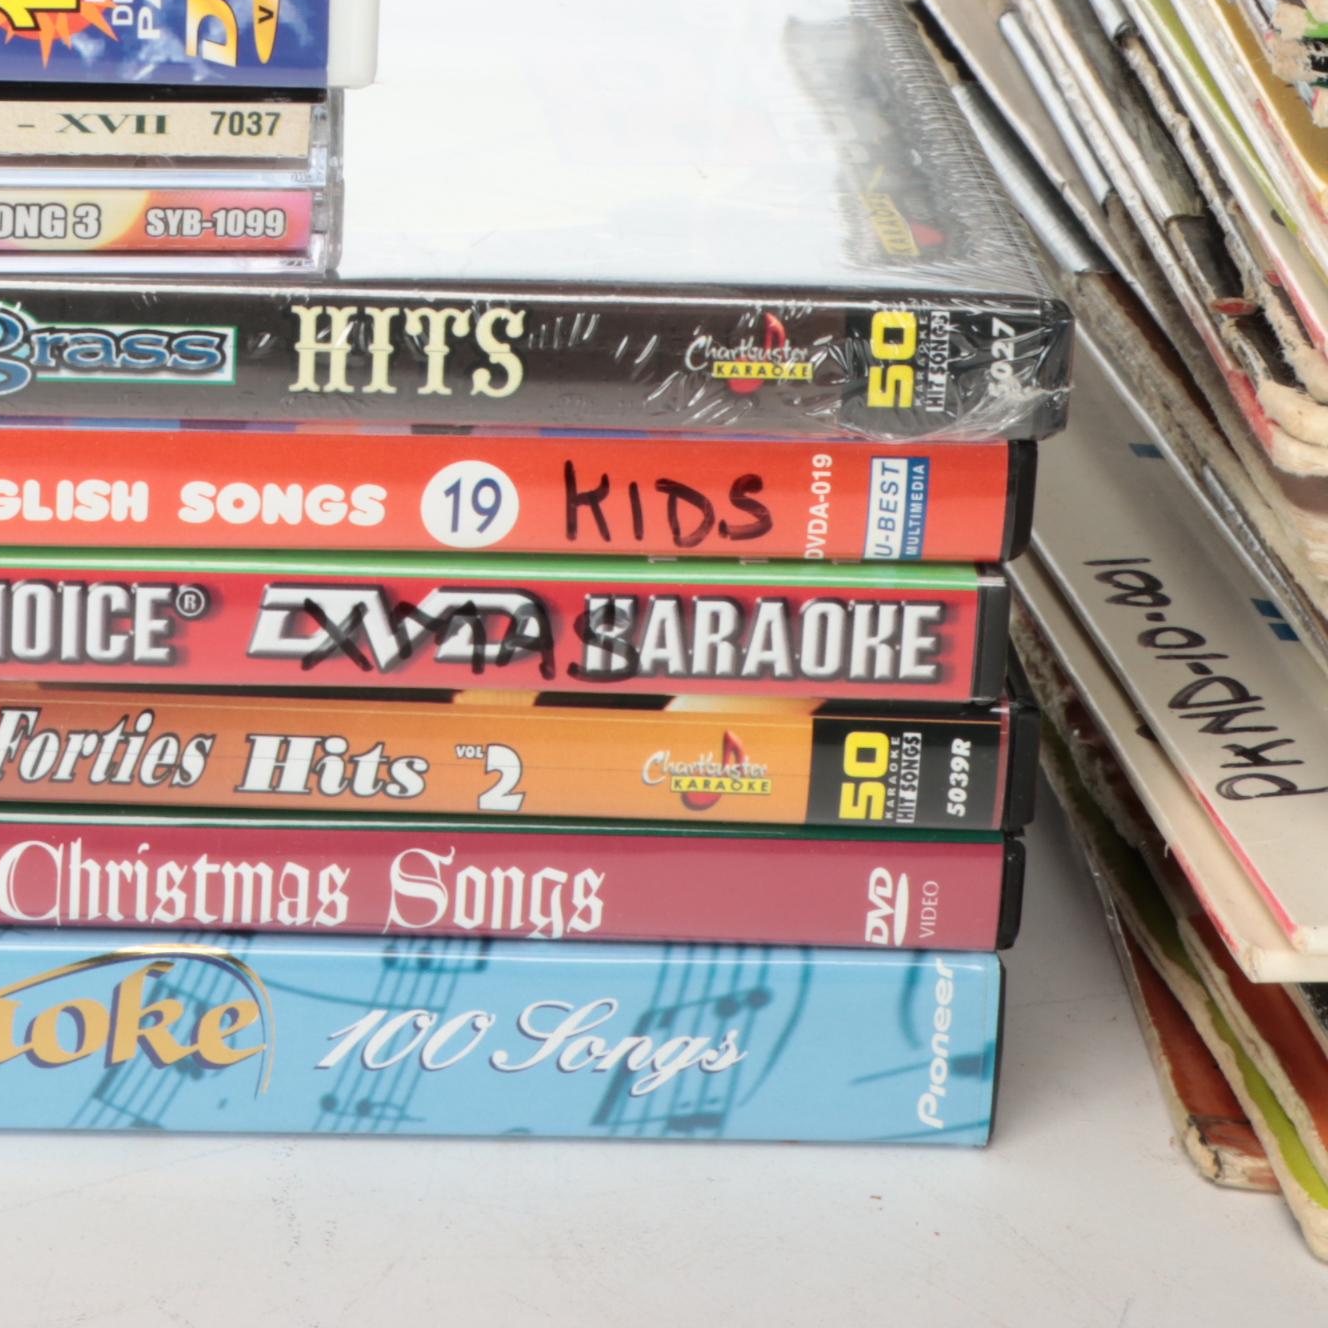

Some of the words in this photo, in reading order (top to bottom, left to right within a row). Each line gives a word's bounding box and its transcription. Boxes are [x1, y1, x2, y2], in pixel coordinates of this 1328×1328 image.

[54, 112, 172, 136] XVII
[209, 110, 282, 138] 7037
[72, 204, 103, 239] 3
[144, 207, 287, 239] SYB-1099
[288, 298, 529, 399] HITS
[684, 334, 808, 371] Chartbuster
[715, 362, 811, 379] KARAOKE
[866, 310, 917, 408] 50
[928, 311, 951, 375] SONGS
[925, 377, 948, 412] HIT
[176, 480, 389, 526] SONGS
[442, 476, 504, 534] 19
[563, 459, 773, 548] KIDS
[873, 460, 902, 559] U-BEST
[906, 463, 926, 557] MULTIMEDIA
[244, 582, 553, 672] DVD
[582, 593, 945, 682] KARAOKE
[233, 731, 431, 800] Hits
[455, 743, 484, 759] VOL
[476, 743, 526, 812] 2
[640, 749, 770, 786] Chartbuster
[672, 778, 771, 794] KARAOKE
[838, 731, 890, 820] 50
[884, 736, 901, 820] KARAOKE
[900, 732, 922, 793] SONGS
[946, 737, 972, 818] 5039R
[896, 794, 917, 824] HIT
[383, 842, 606, 939] Songs
[864, 866, 896, 946] DVD
[919, 880, 940, 939] VIDEO
[316, 1008, 495, 1073] 100
[489, 998, 748, 1096] Songs
[916, 958, 957, 1130] Pioneer
